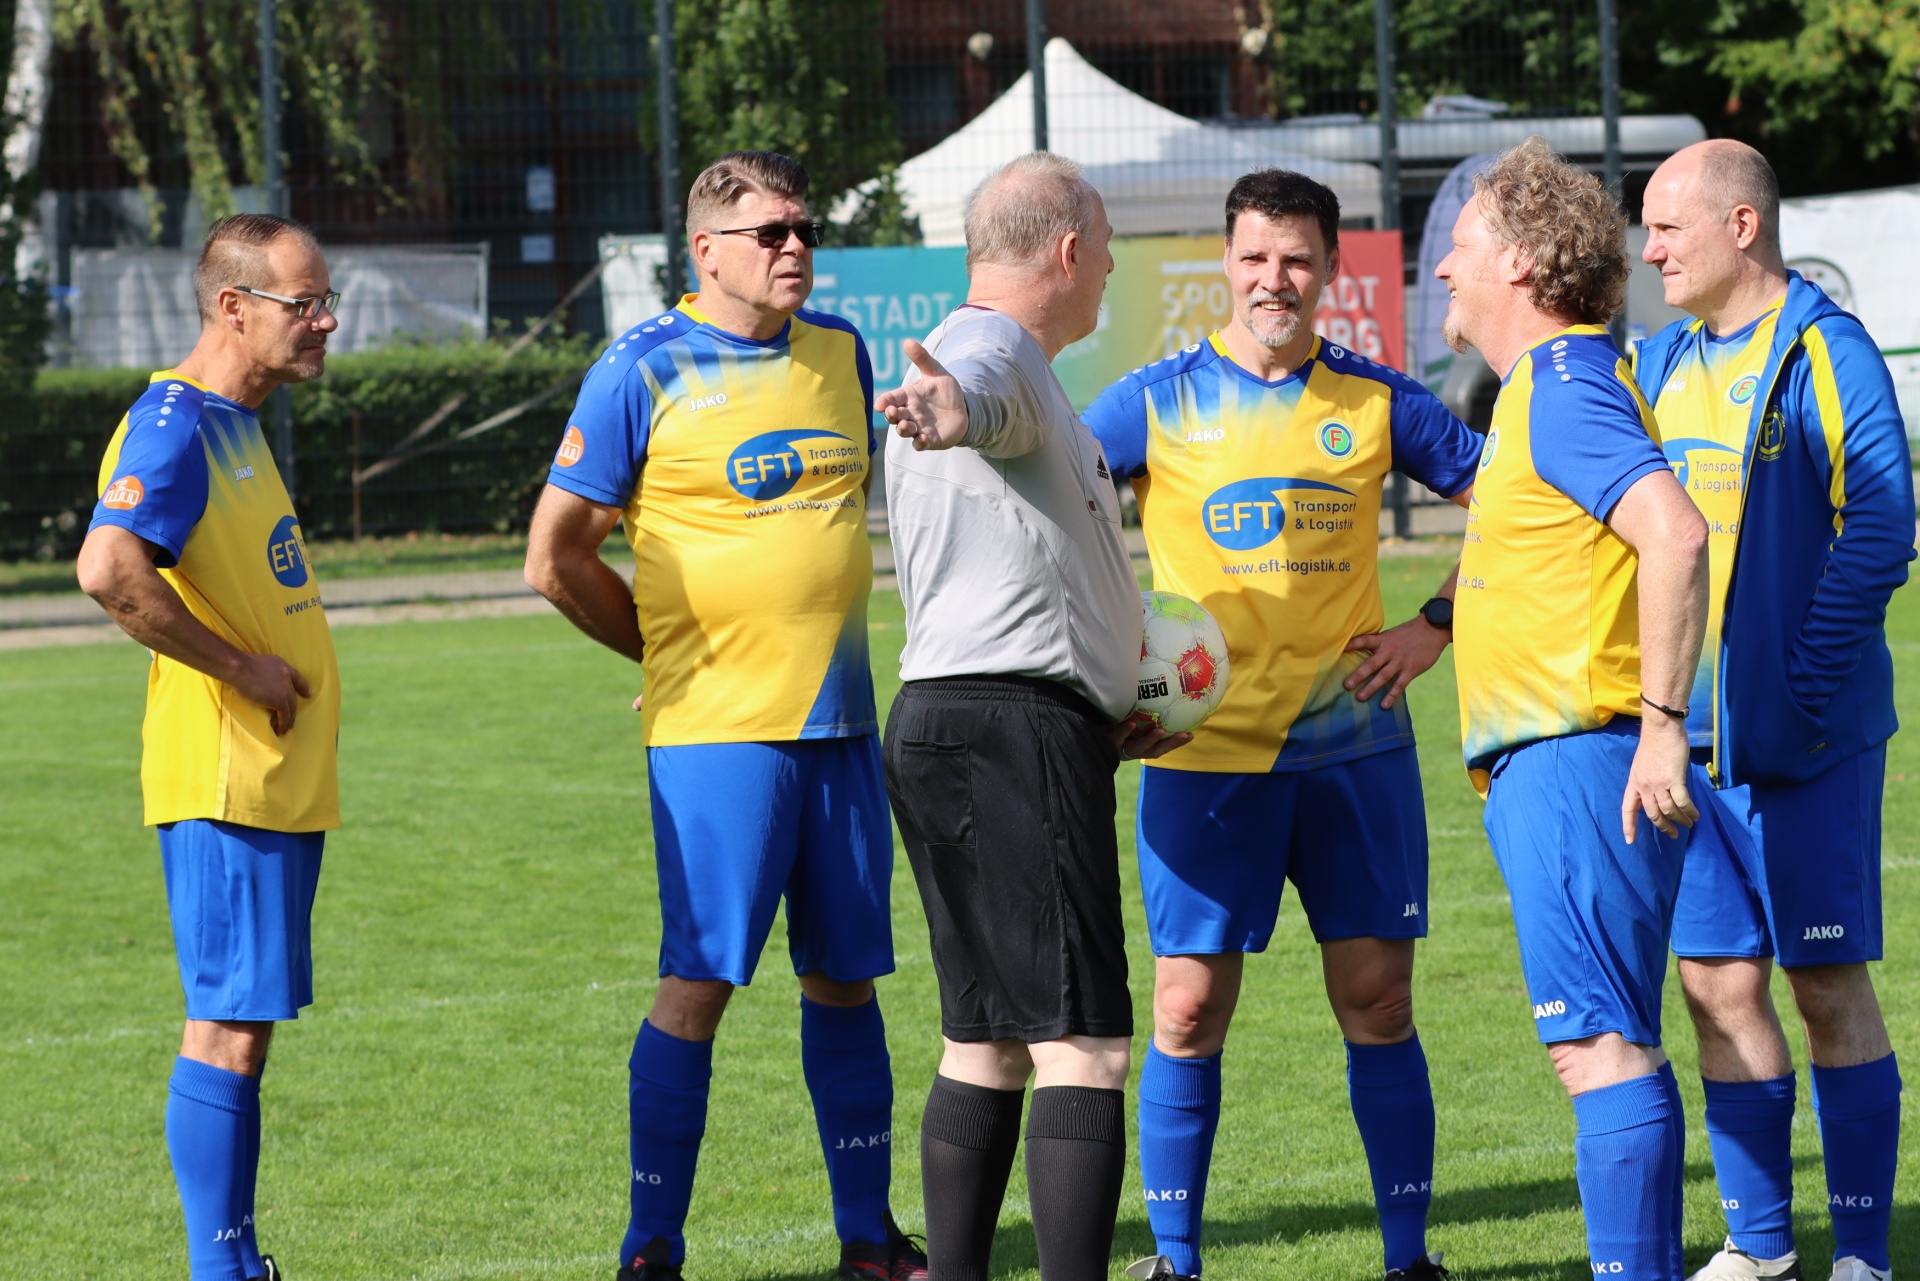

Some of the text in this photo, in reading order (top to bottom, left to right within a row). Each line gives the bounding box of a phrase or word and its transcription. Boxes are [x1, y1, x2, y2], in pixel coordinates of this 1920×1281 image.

[689, 392, 727, 412] JAKO
[1185, 429, 1225, 442] JAKO
[1330, 429, 1342, 448] F
[808, 446, 859, 461] Transport
[235, 465, 254, 481] JAKO
[733, 452, 794, 485] EFT
[812, 461, 864, 476] & Logistik
[1696, 461, 1742, 474] Transpor
[1694, 478, 1741, 493] & Logisti
[1294, 501, 1357, 515] Transport
[1209, 502, 1276, 533] EFT
[1295, 518, 1353, 532] & Logistik
[1221, 558, 1351, 575] www.eft-logistik.de
[1803, 924, 1844, 940] JAKO
[835, 1131, 890, 1149] JAKO
[630, 1165, 661, 1185] KO
[1390, 1180, 1432, 1195] JAK
